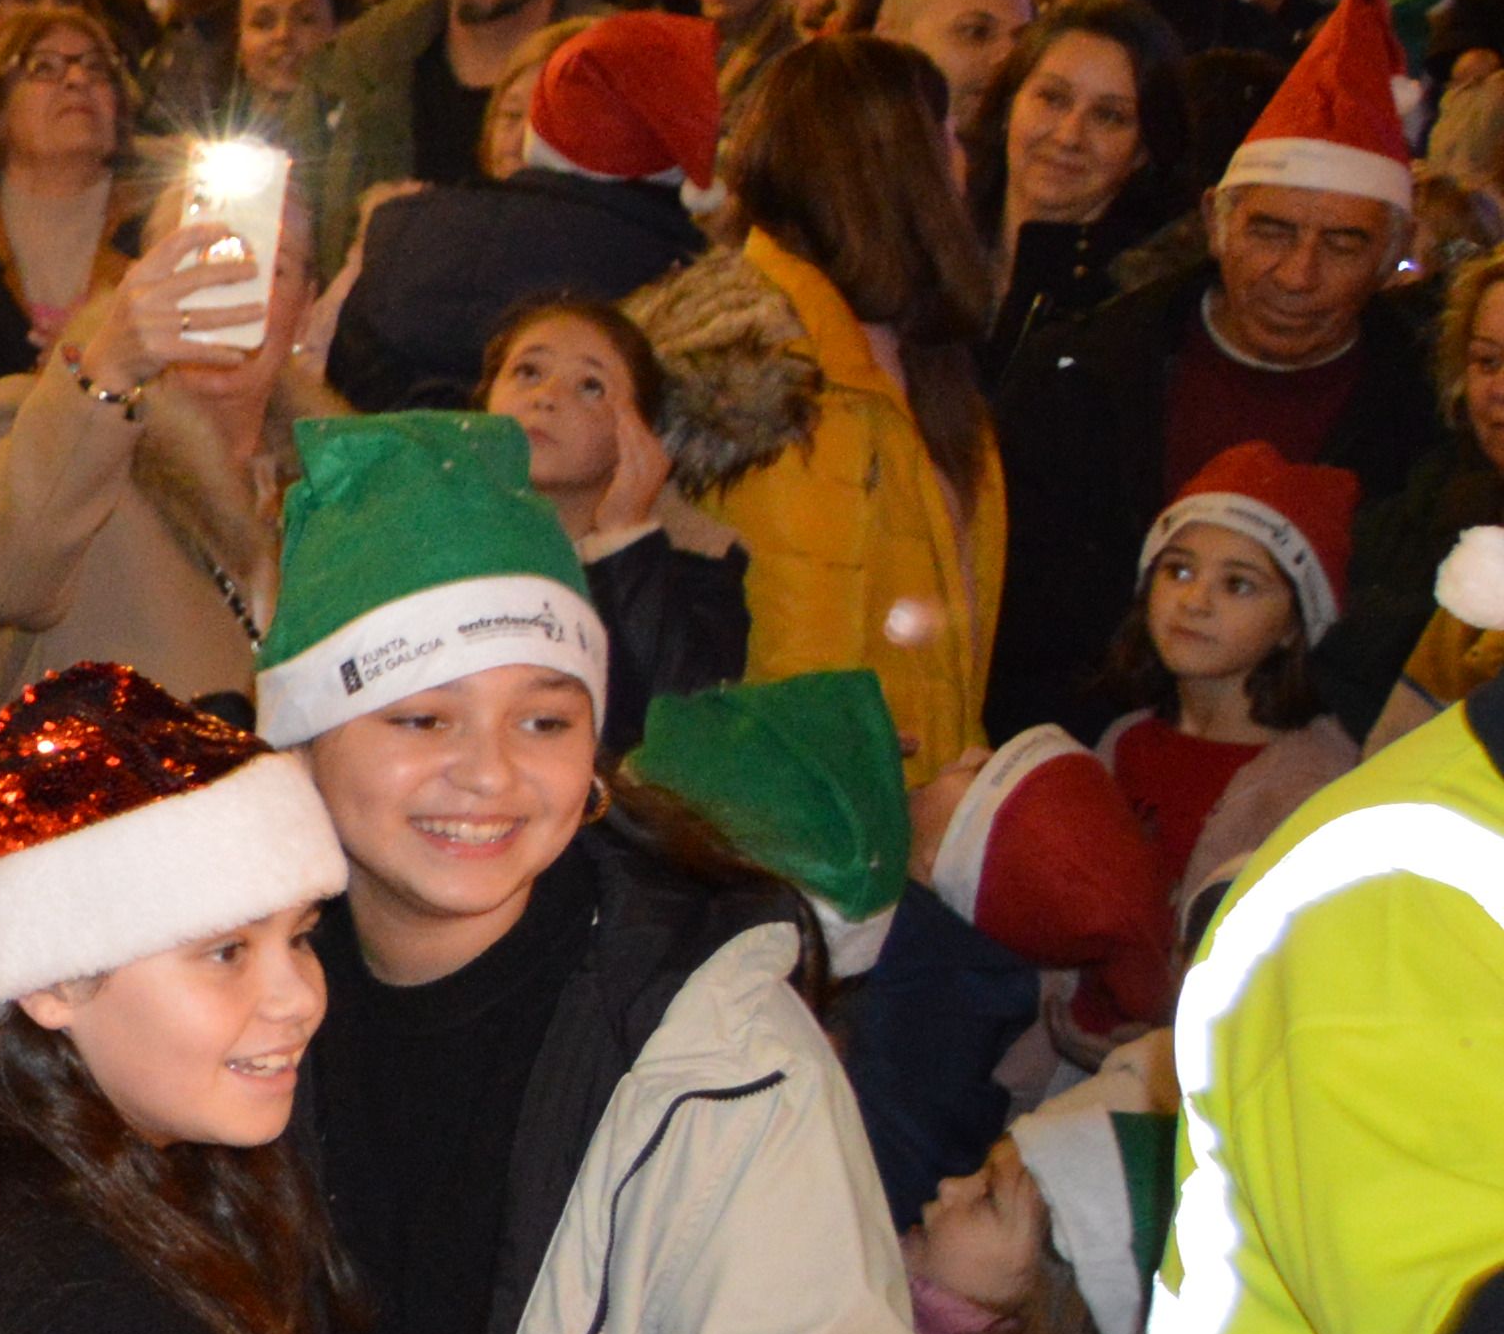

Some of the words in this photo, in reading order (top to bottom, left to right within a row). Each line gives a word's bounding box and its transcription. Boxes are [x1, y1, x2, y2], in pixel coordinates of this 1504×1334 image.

[360, 637, 410, 666] XUNTA
[364, 666, 382, 683] DE
[384, 636, 446, 670] GALICIA
